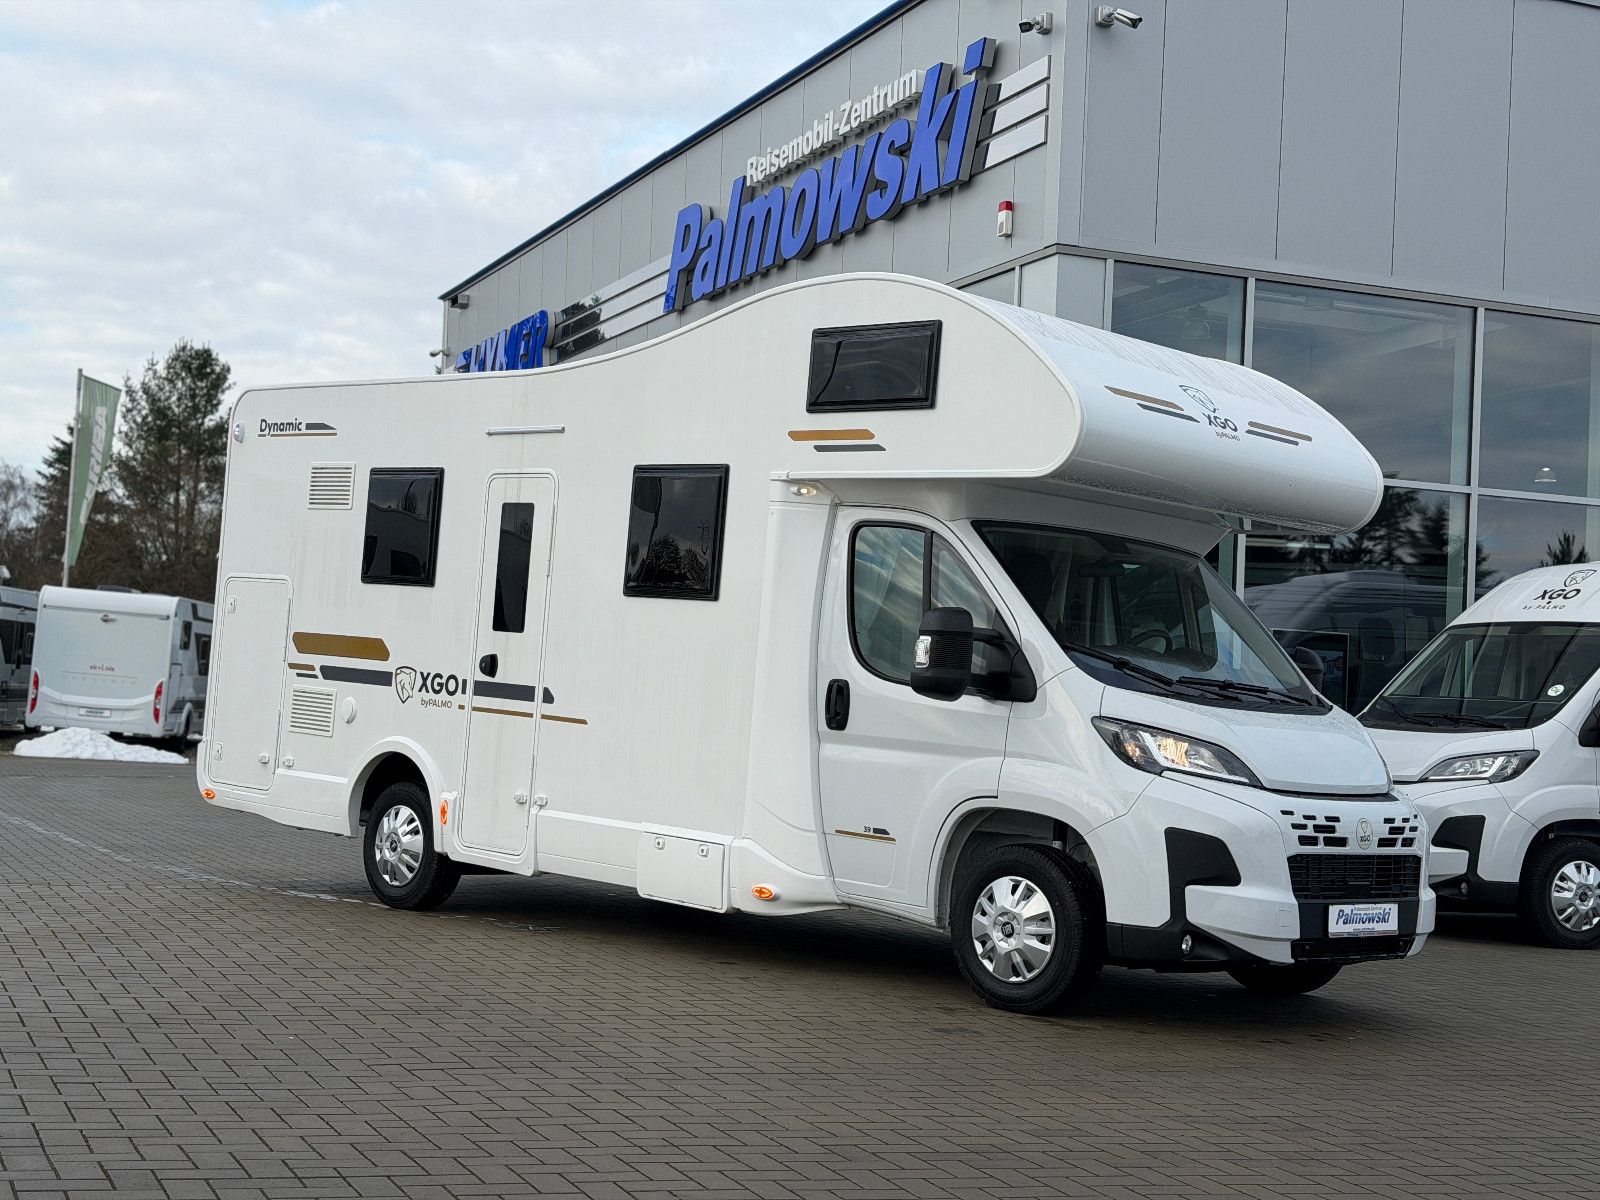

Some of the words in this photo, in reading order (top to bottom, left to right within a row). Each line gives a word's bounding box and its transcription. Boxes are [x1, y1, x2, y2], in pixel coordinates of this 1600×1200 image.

[746, 68, 921, 187] Reisemobil-Zentrum
[663, 37, 992, 313] Palmowski
[259, 418, 303, 436] Dynamic
[1202, 411, 1238, 432] XGO
[1533, 588, 1582, 600] XGO
[418, 671, 459, 696] XGO
[1335, 908, 1392, 926] Palmowski
